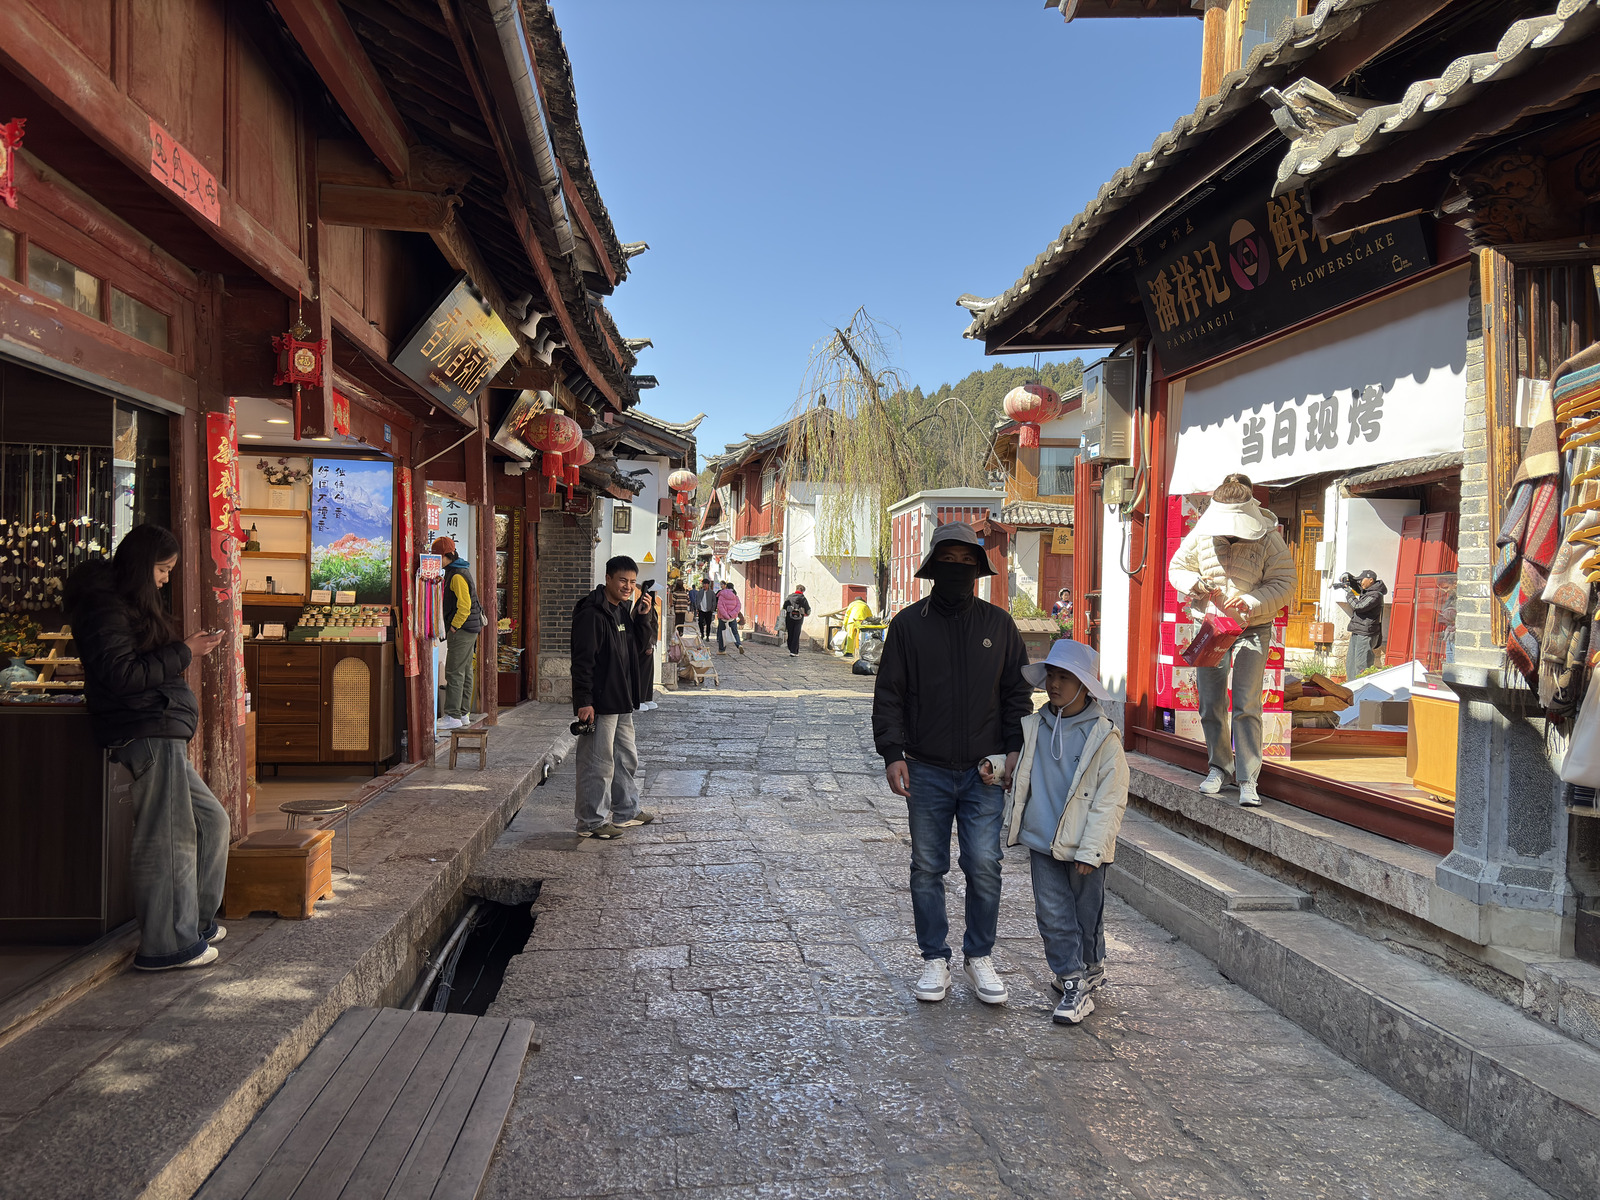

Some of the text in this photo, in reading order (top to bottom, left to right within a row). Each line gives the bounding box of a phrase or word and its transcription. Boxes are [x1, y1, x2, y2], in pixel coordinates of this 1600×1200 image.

[1147, 240, 1231, 333] 潘祥记
[1290, 232, 1395, 291] FLOWERSCAKE
[1166, 311, 1235, 350] PANXIANGJI
[1240, 384, 1385, 466] 当日现烤
